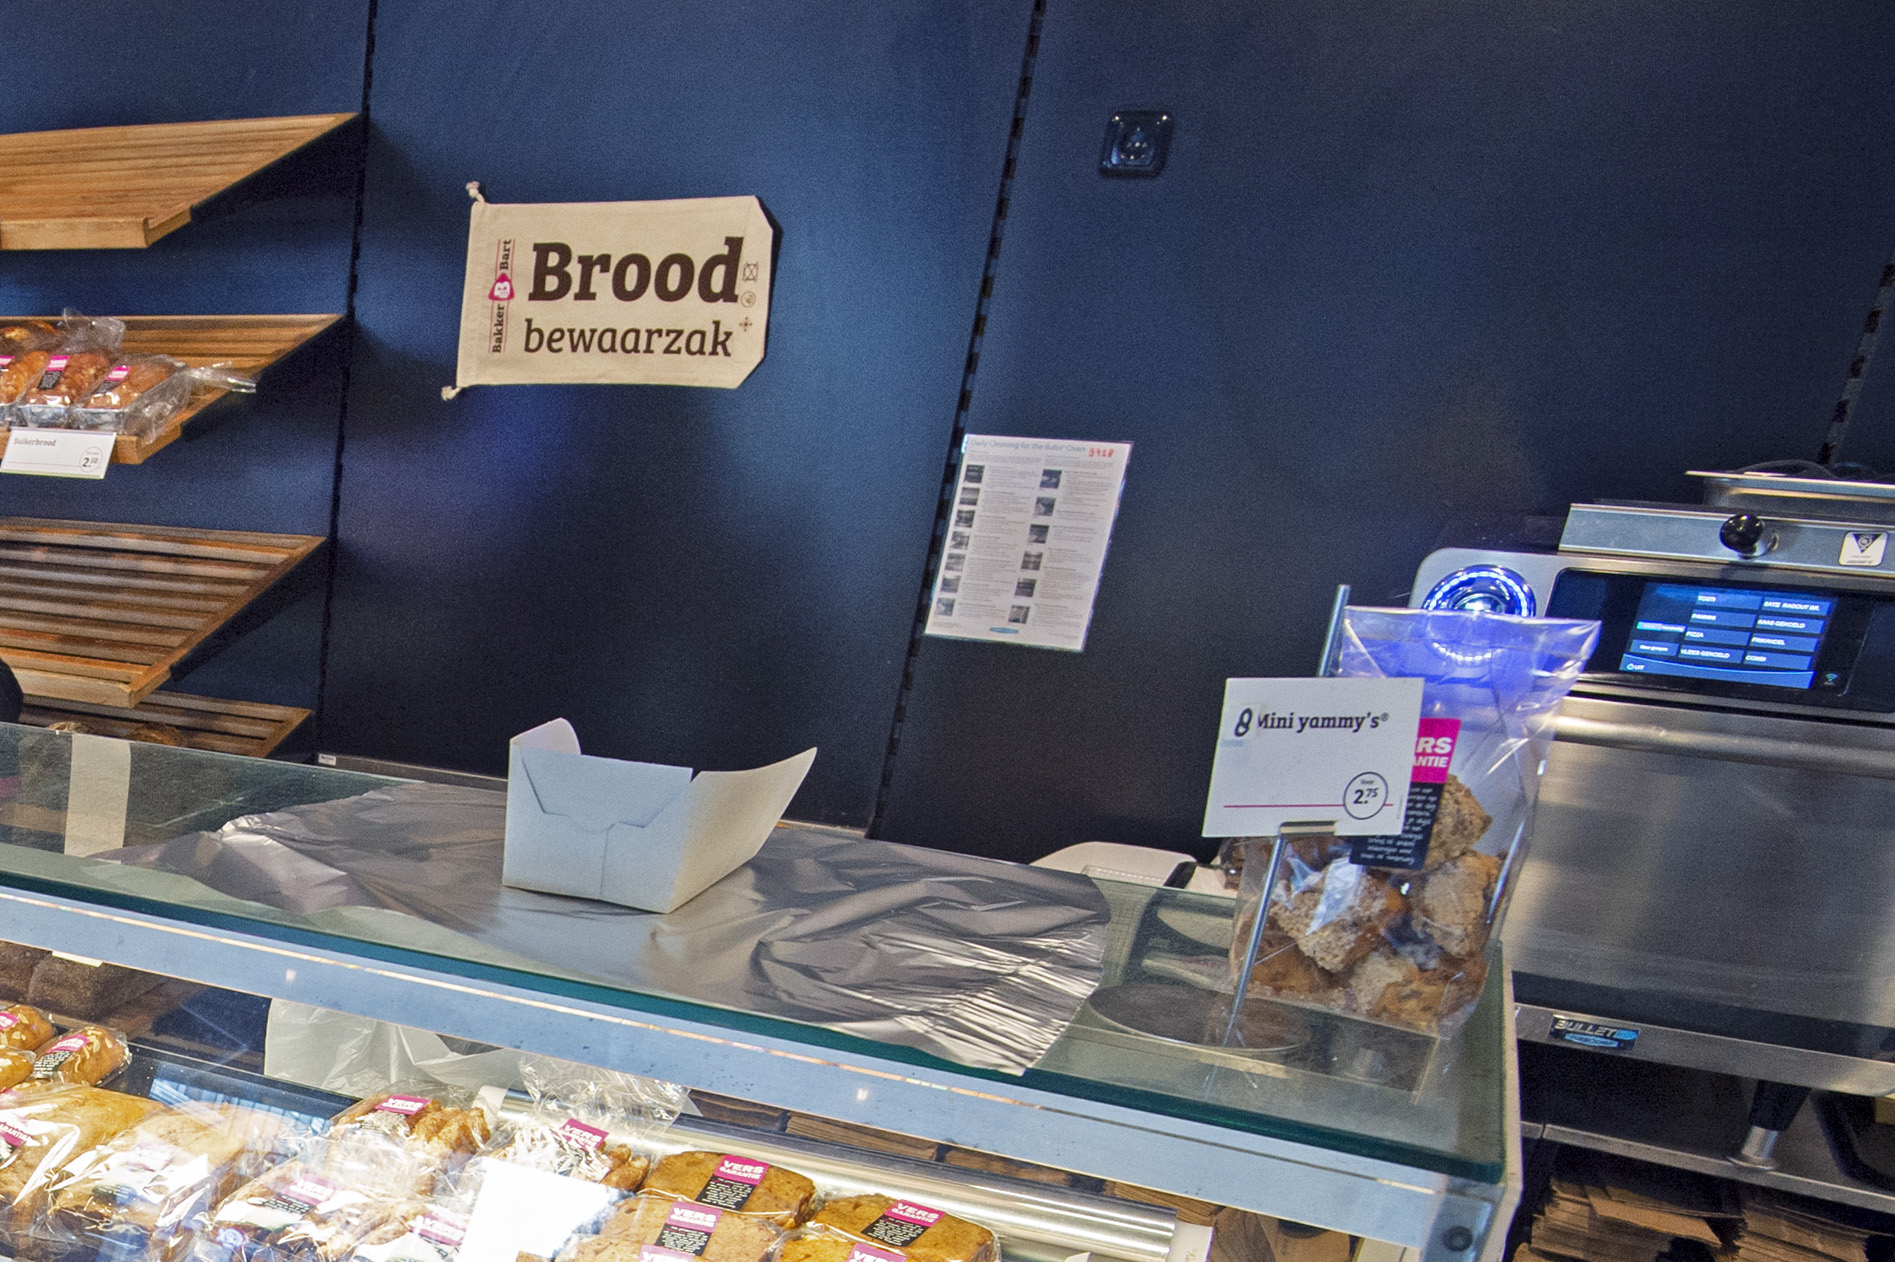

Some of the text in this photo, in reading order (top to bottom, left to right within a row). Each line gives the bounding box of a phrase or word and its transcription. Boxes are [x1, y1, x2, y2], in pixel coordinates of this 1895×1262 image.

[500, 239, 512, 270] Bart
[528, 236, 744, 303] Brood
[492, 304, 506, 353] Bakker
[524, 318, 733, 357] bewaarzak
[13, 438, 57, 446] Suikerbrood
[1234, 708, 1252, 737] 8
[1258, 712, 1294, 729] Mini
[1353, 787, 1379, 804] 2.75
[1554, 1019, 1618, 1038] BULLET
[718, 1166, 763, 1181] GARANTIE
[722, 1159, 765, 1176] VERS
[672, 1206, 718, 1222] VERS
[891, 1208, 939, 1225] GARANTIE
[895, 1202, 941, 1219] VERS
[669, 1213, 716, 1229] GARANTIE
